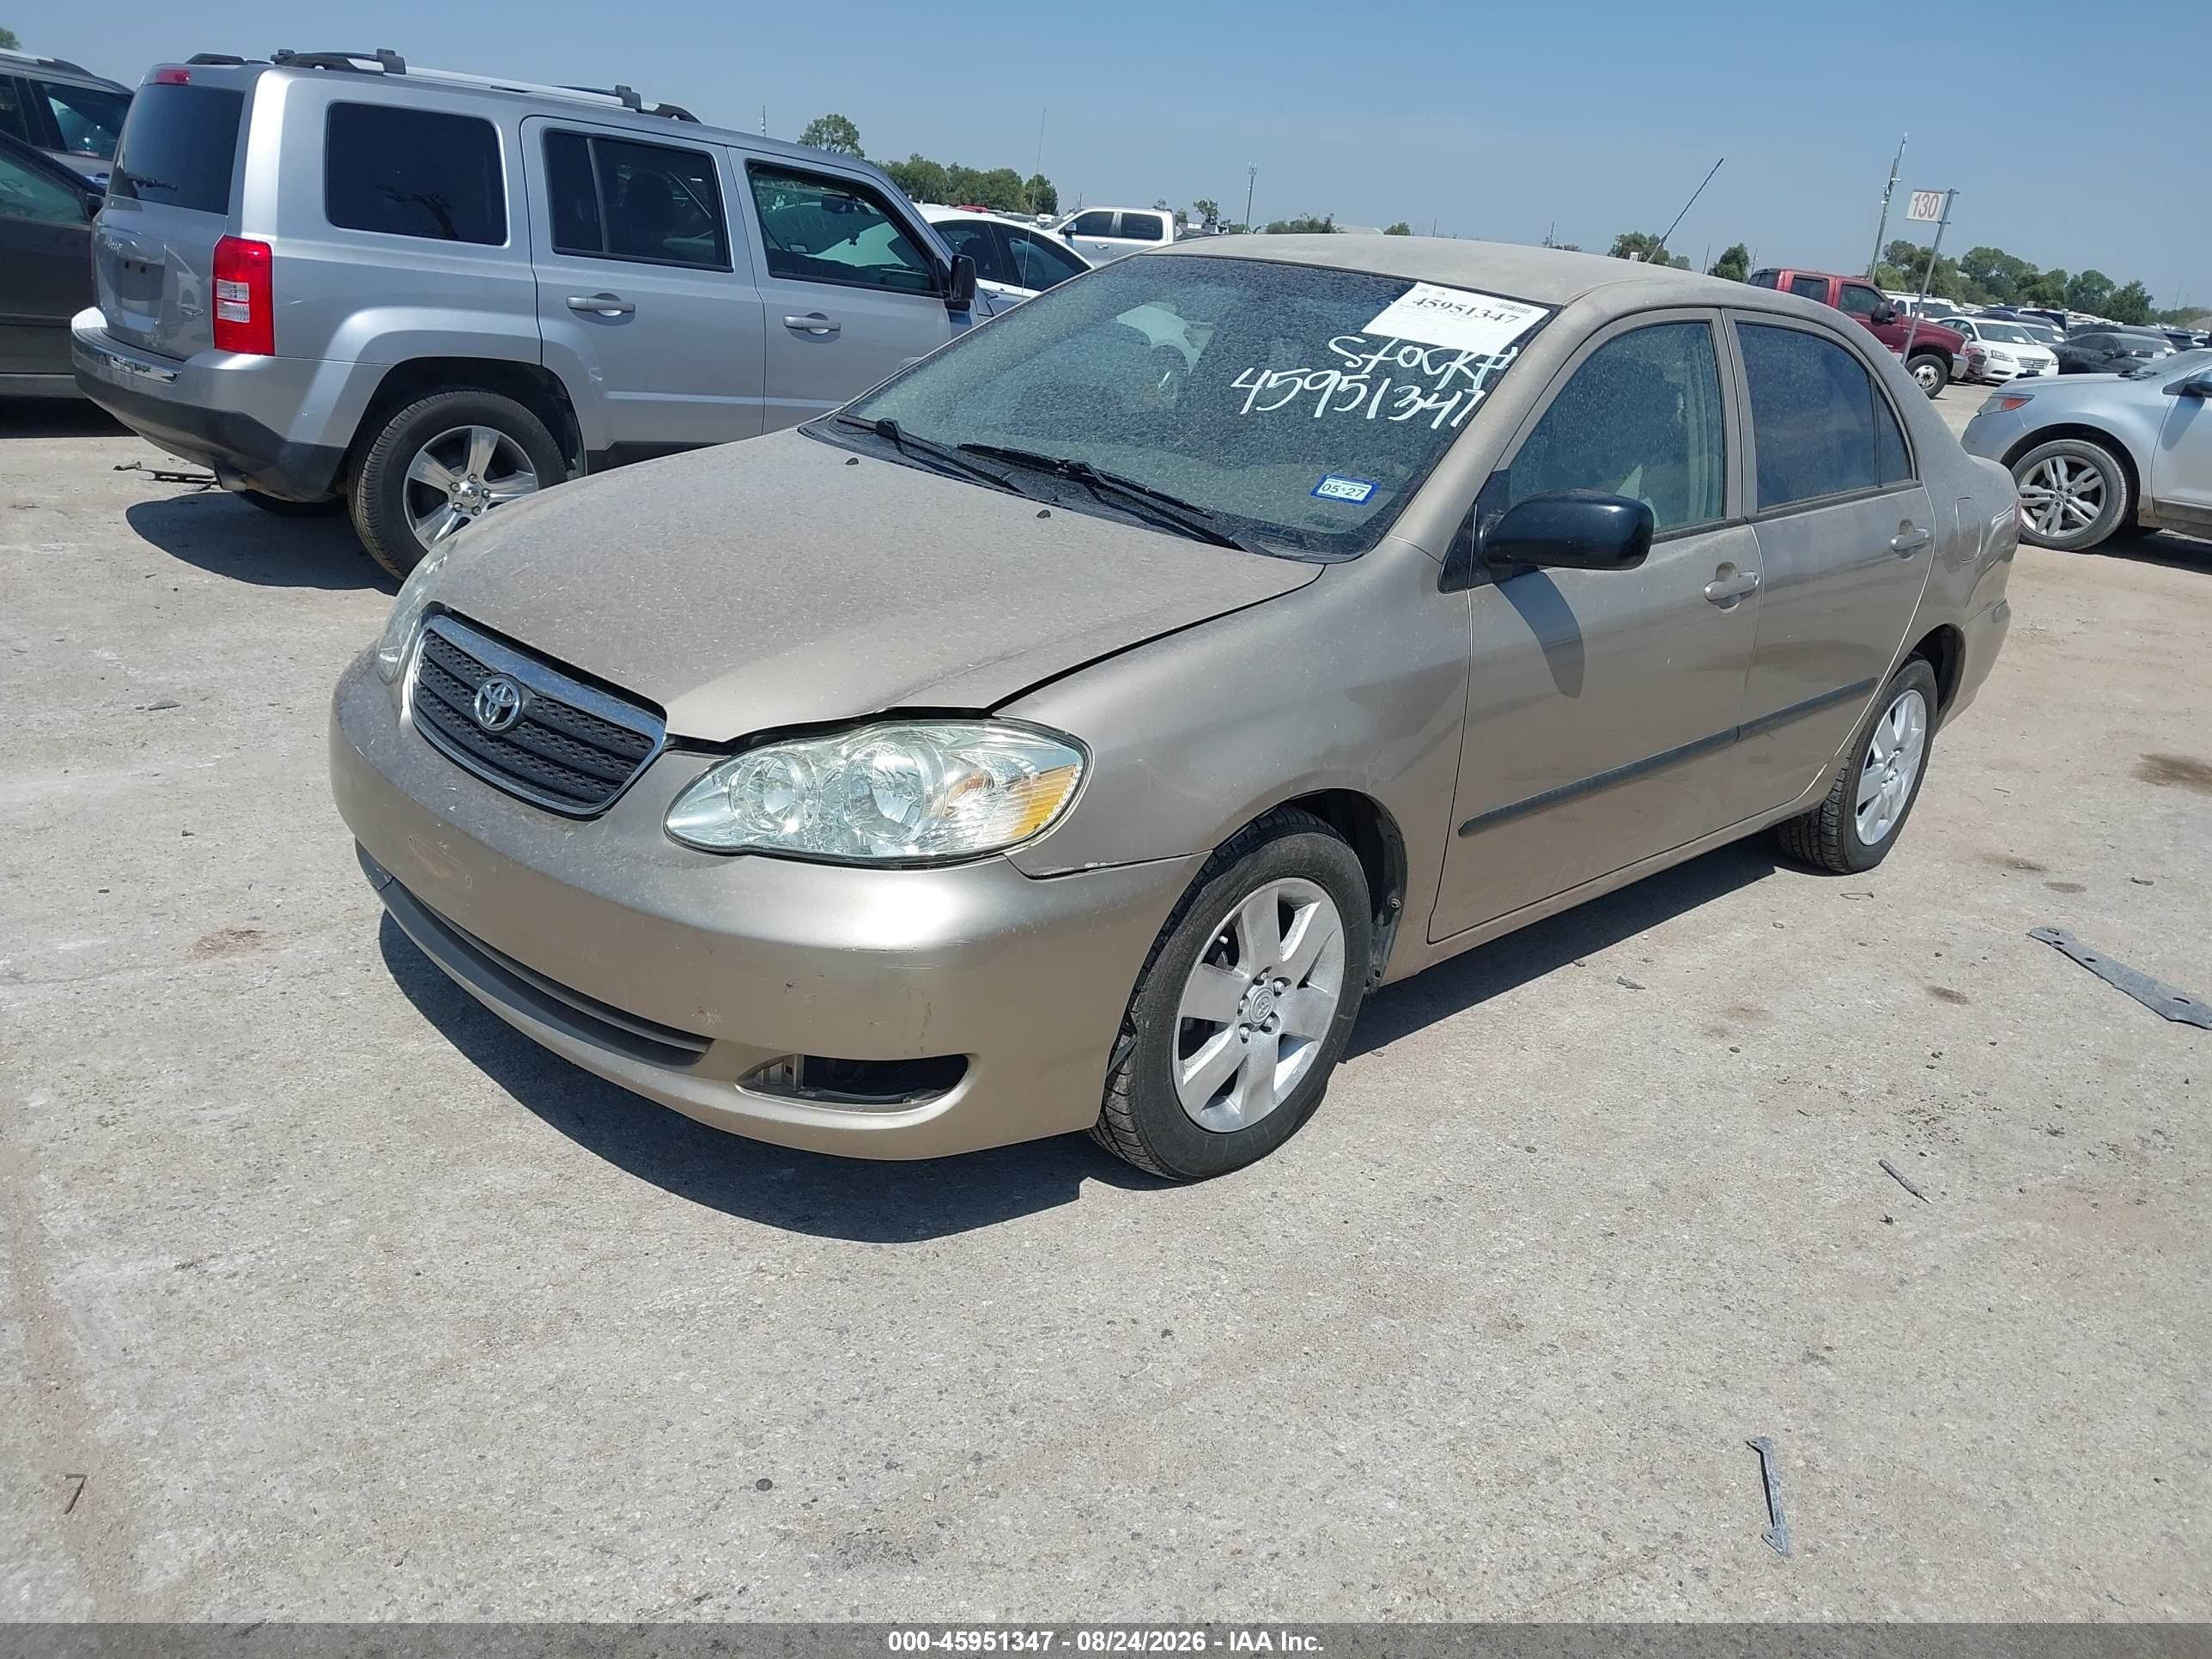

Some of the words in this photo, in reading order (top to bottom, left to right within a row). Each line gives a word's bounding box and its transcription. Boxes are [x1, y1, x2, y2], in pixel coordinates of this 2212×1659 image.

[1912, 193, 1940, 219] 130
[1412, 297, 1521, 324] 45951347
[1231, 367, 1486, 429] 45951347
